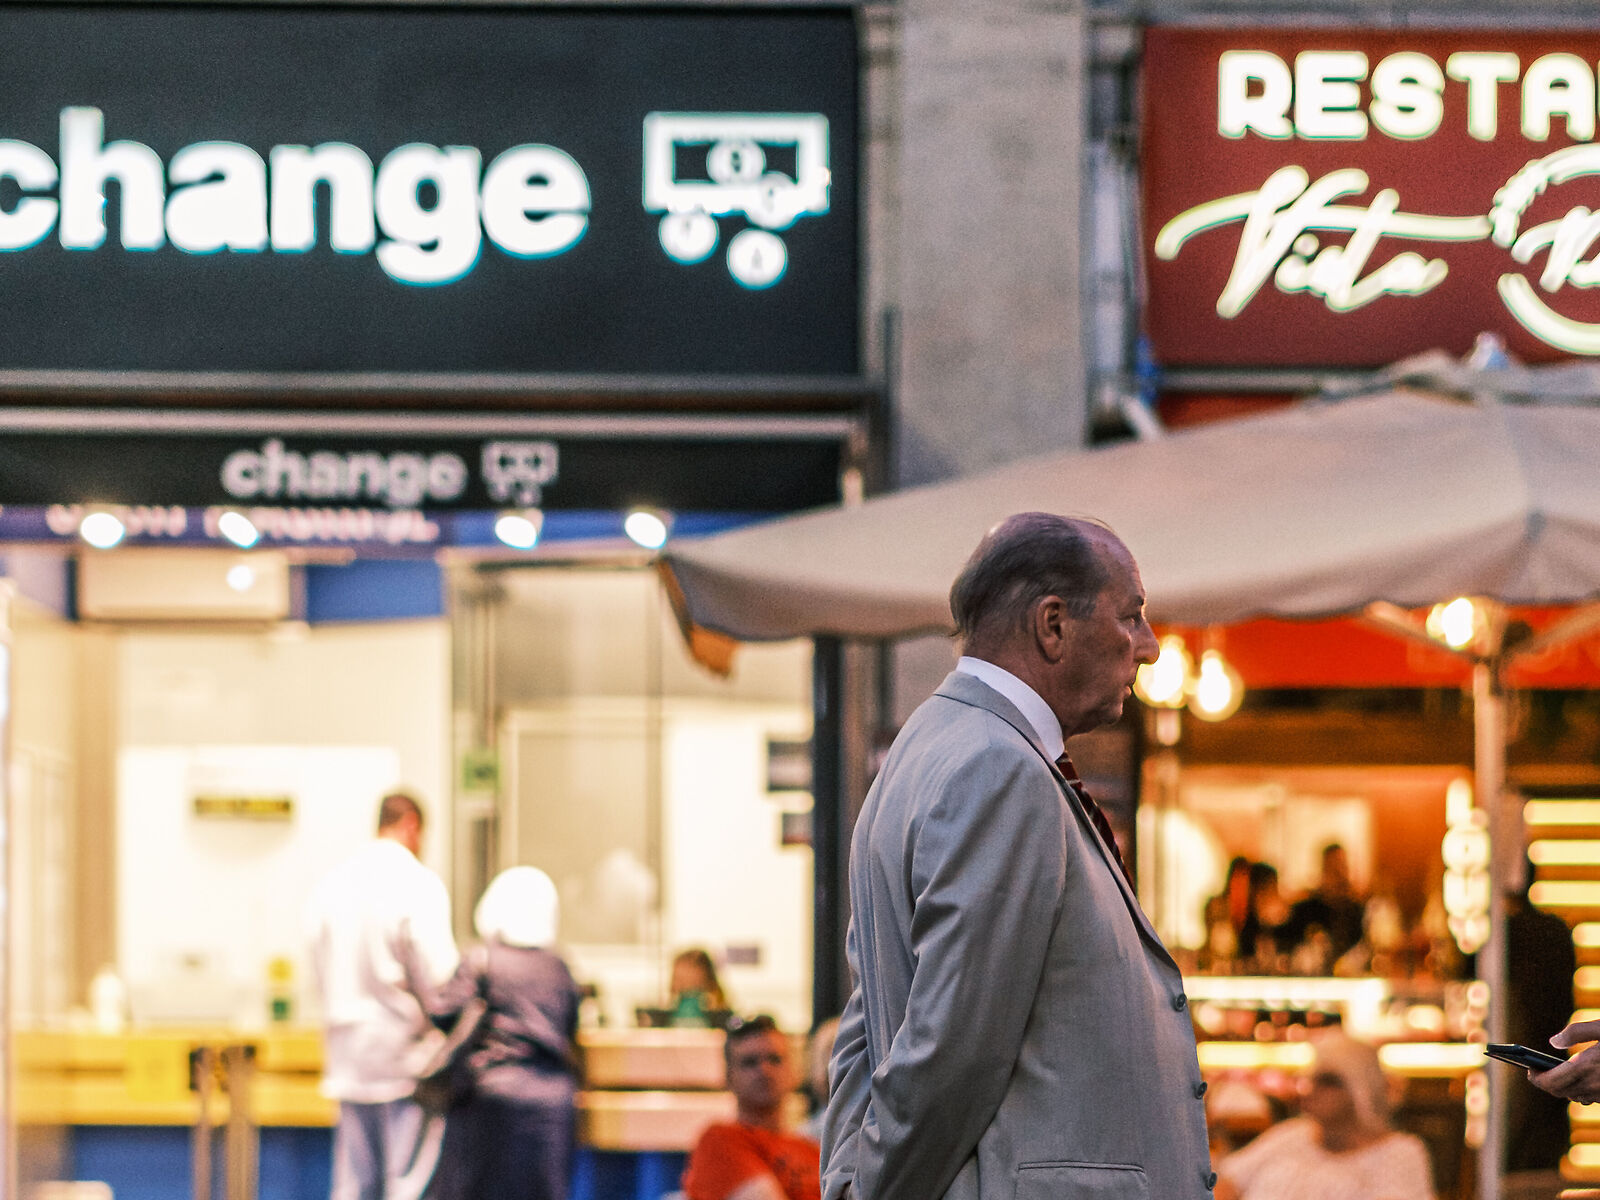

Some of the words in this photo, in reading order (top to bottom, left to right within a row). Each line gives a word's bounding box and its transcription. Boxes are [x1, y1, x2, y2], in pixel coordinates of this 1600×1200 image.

[1218, 50, 1600, 142] RESTA
[0, 106, 591, 284] change
[221, 439, 467, 506] change
